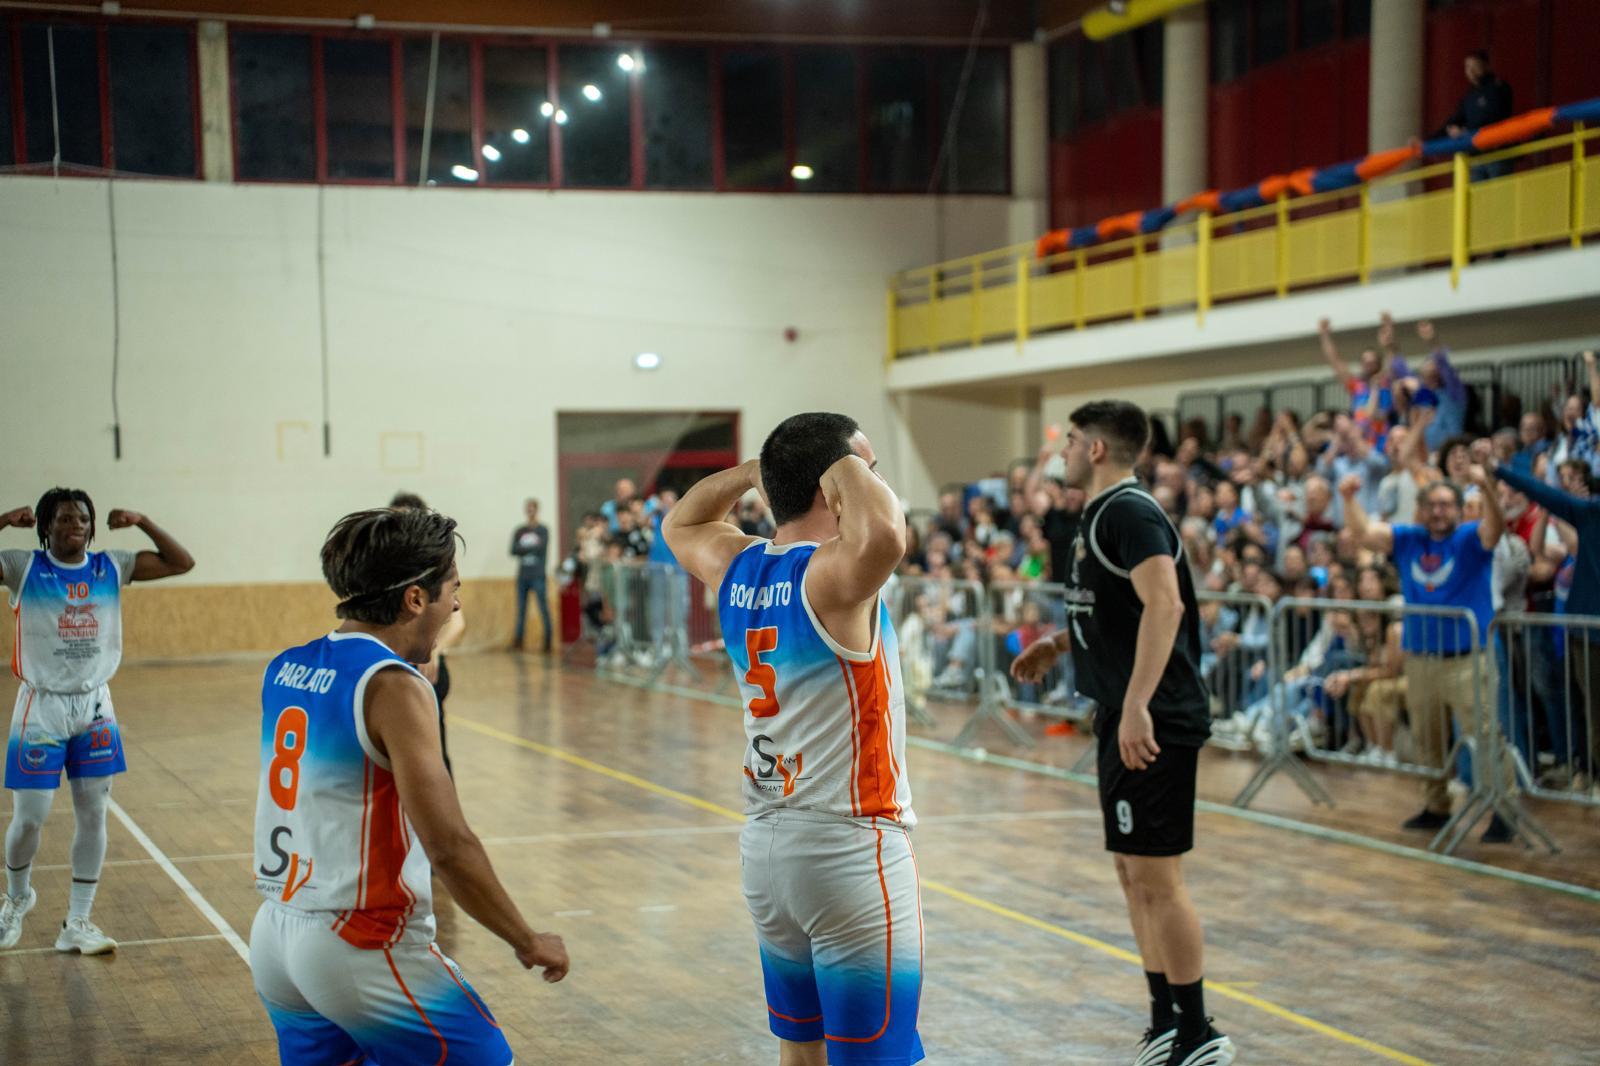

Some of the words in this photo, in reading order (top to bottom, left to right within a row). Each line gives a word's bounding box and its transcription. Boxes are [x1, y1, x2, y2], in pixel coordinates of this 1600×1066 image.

[66, 582, 89, 600] 10
[273, 661, 337, 694] PARLATO
[744, 625, 781, 718] 5
[90, 727, 112, 749] 10
[268, 705, 309, 811] 8
[1116, 799, 1134, 835] 9
